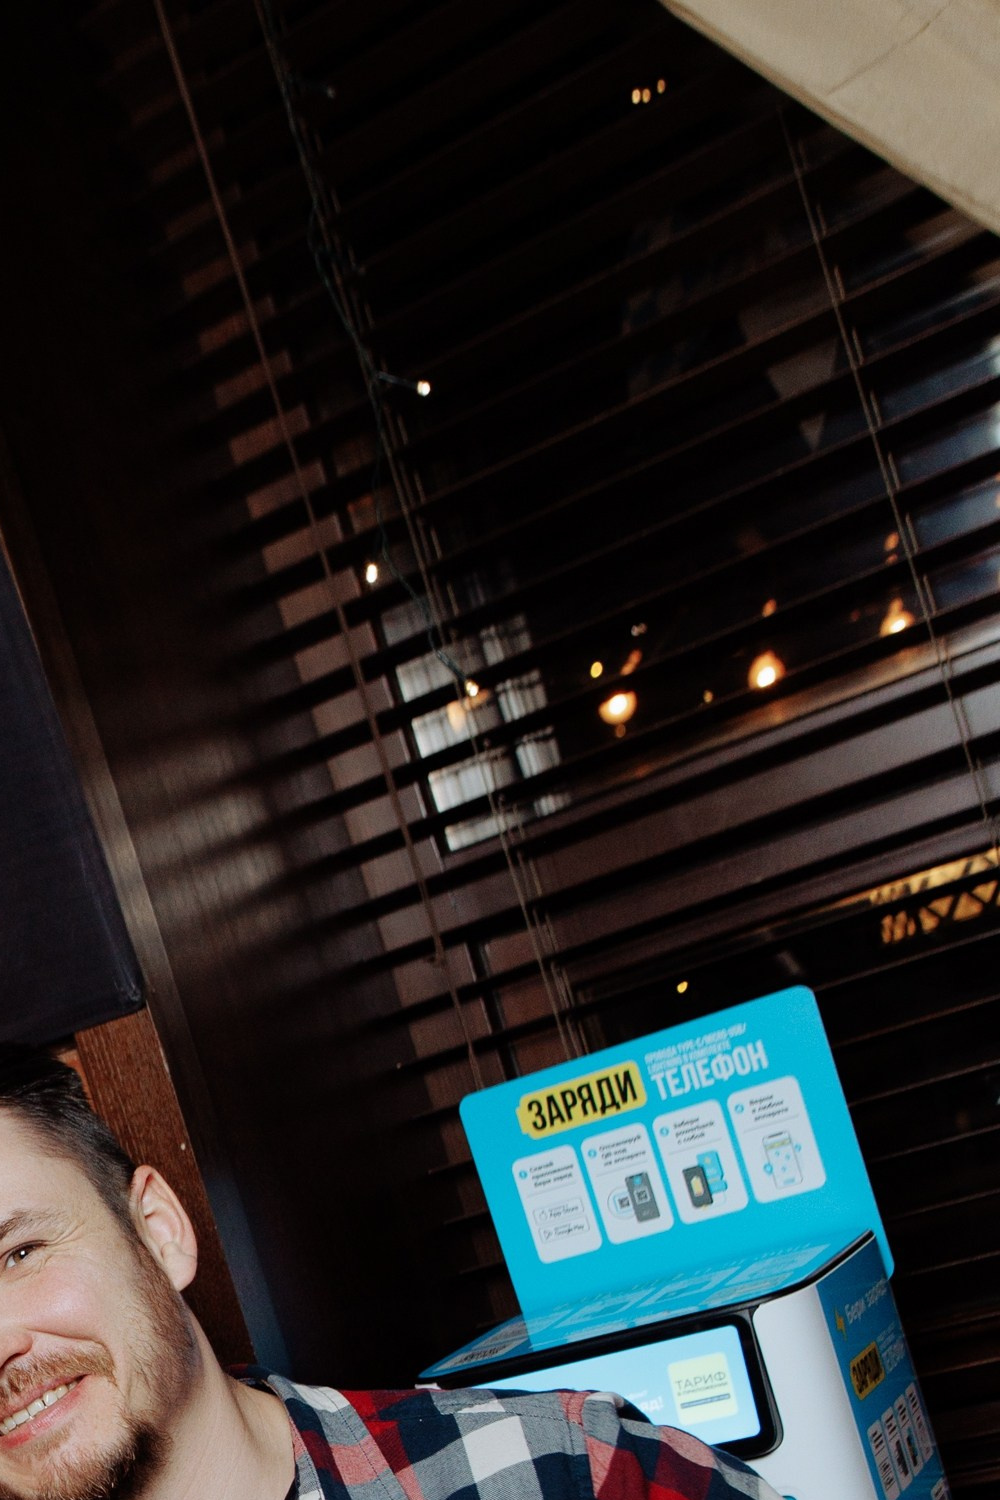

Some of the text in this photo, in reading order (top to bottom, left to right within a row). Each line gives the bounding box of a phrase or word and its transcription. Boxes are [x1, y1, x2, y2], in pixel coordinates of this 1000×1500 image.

[527, 1070, 638, 1131] ЗАРЯДИ
[650, 1039, 769, 1101] ТЕЛЕФОН
[674, 1371, 727, 1391] ТАРИФ
